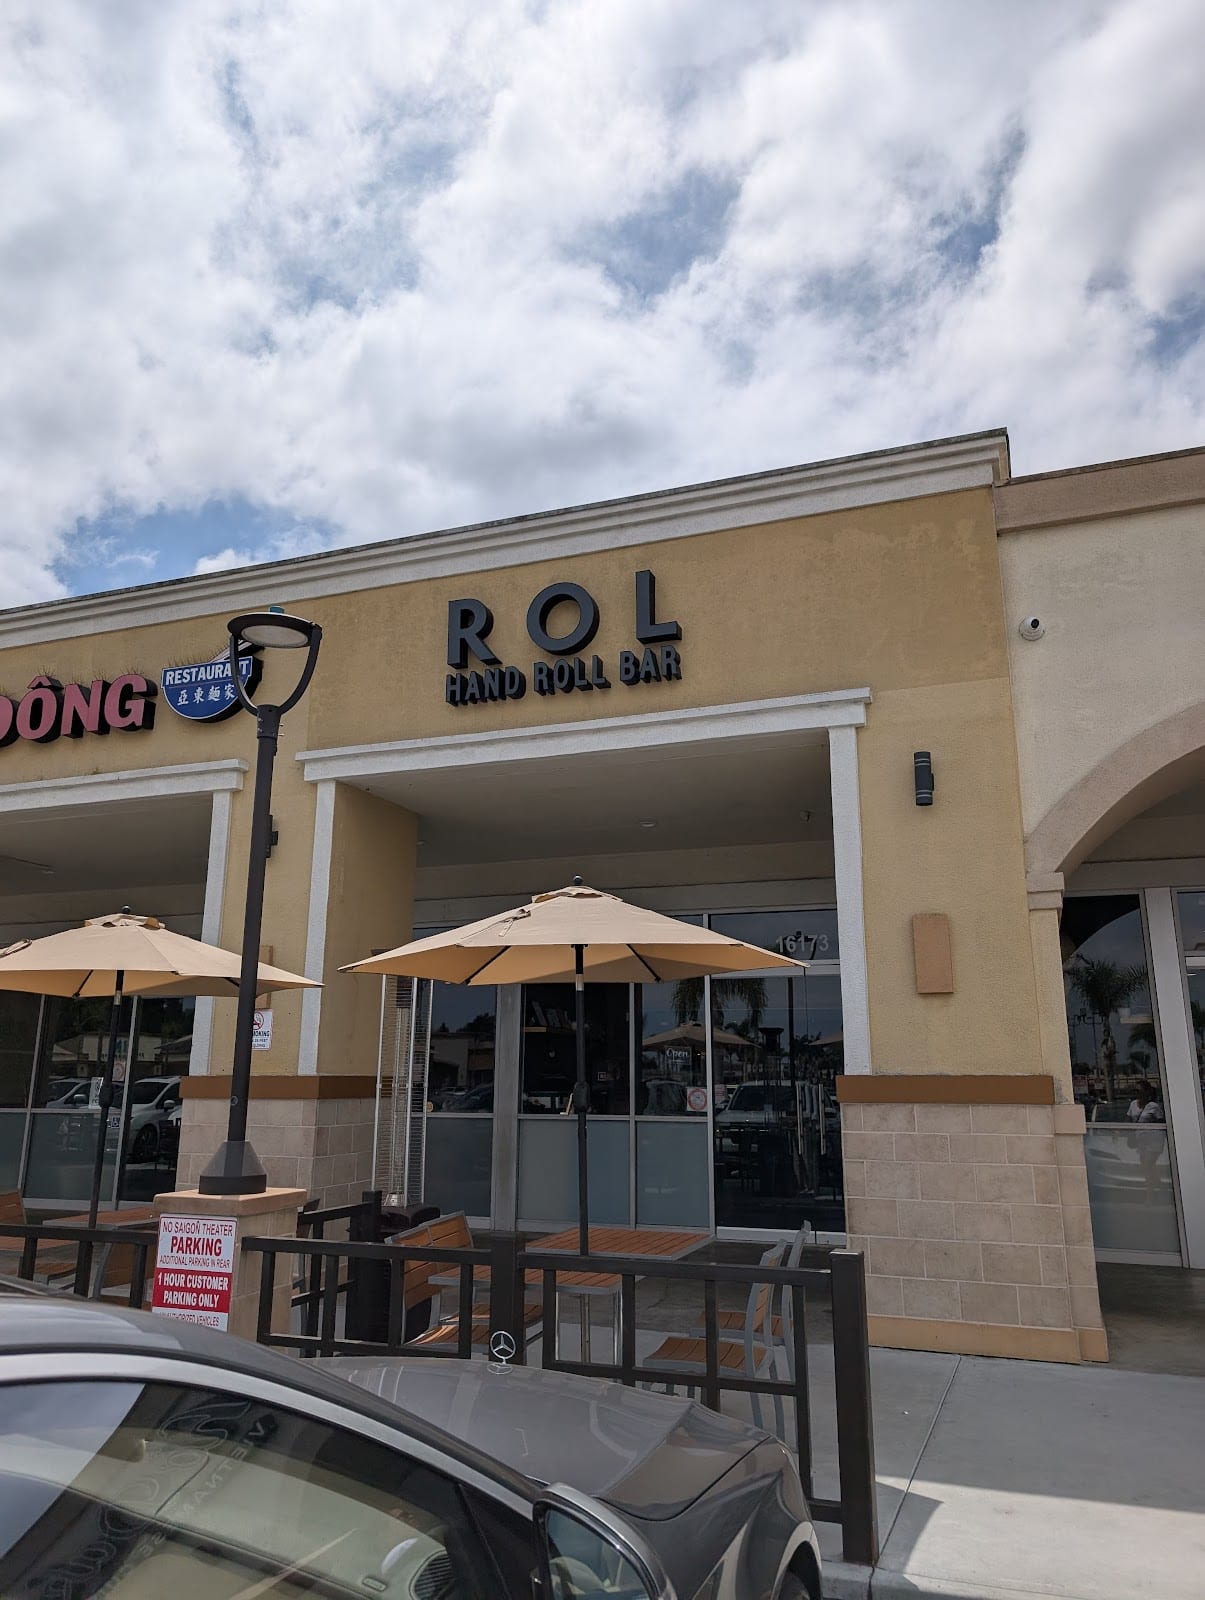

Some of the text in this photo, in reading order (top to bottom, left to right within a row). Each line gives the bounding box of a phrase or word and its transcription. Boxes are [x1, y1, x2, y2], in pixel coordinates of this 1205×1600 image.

[447, 569, 683, 669] ROL
[165, 660, 250, 686] RESTAURAT
[445, 645, 682, 707] HAND ROLL BAR
[776, 934, 829, 953] 16173
[666, 1047, 689, 1061] Open
[163, 1221, 233, 1237] NO SAIGON THEATER
[171, 1236, 222, 1257] PARKING
[160, 1255, 230, 1269] ADDITIONAL PARKING IN REAR
[158, 1272, 229, 1291] 1 HOUR CUSTOMER
[163, 1290, 220, 1308] PARKING ONLY
